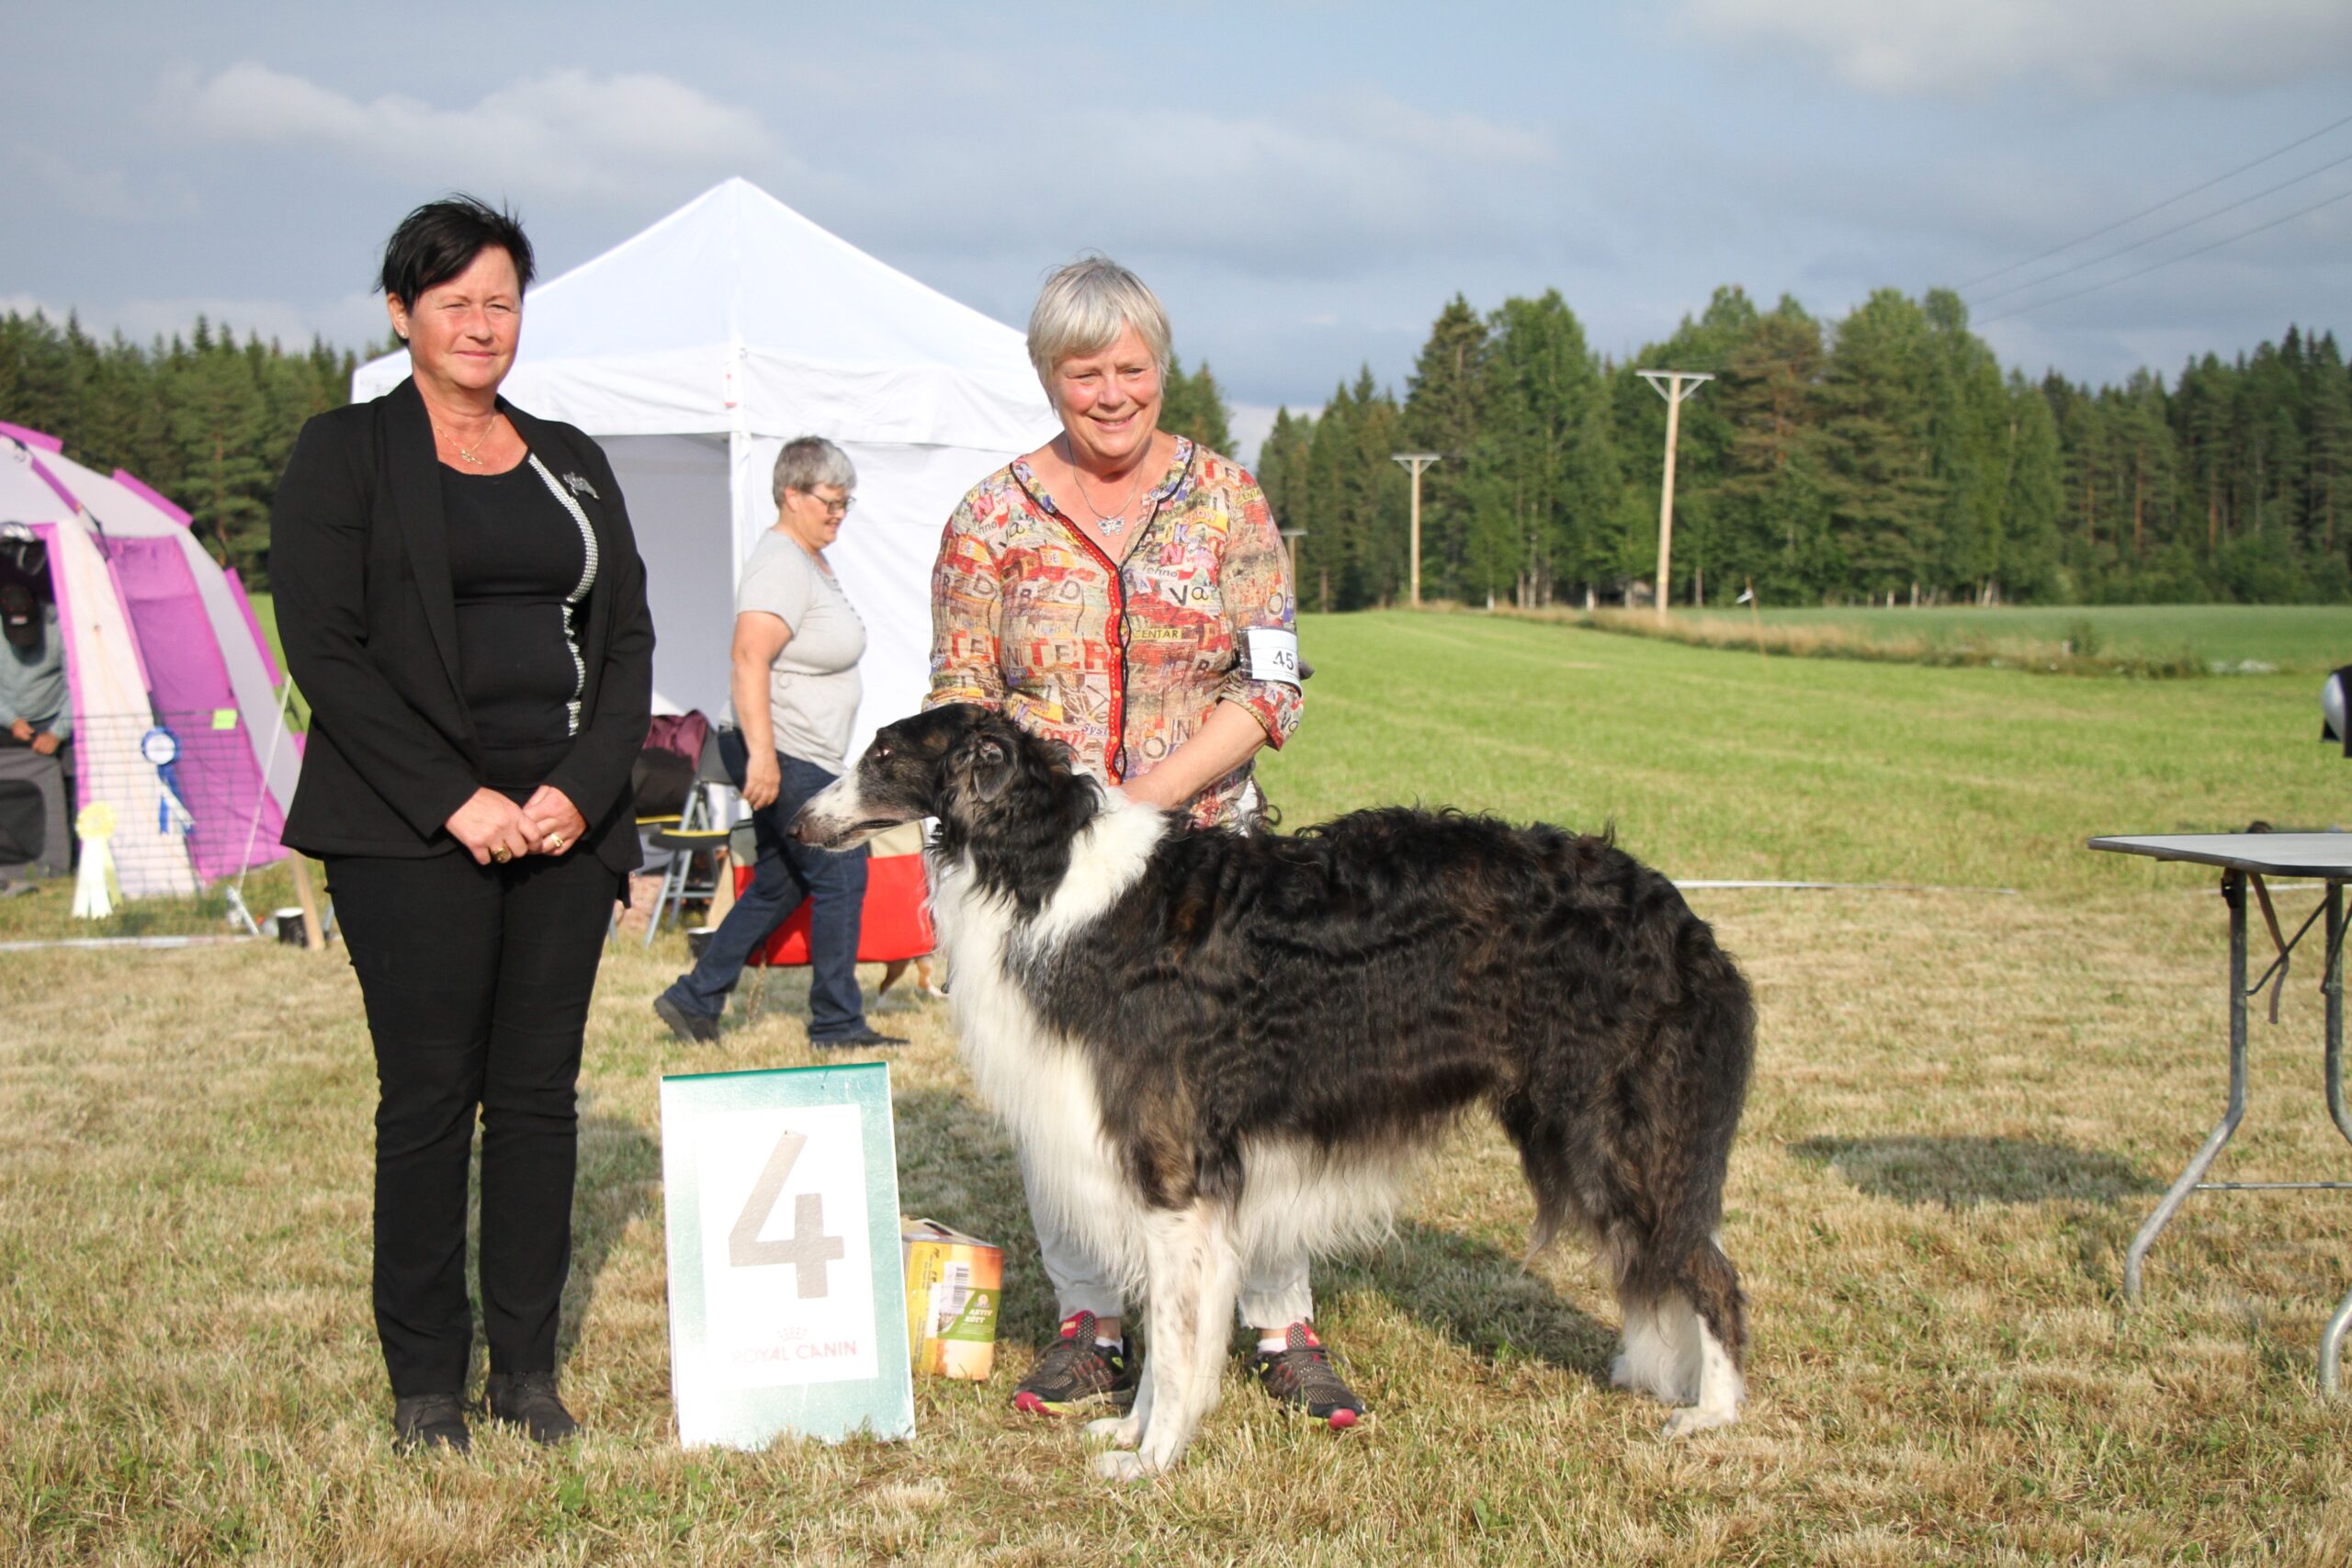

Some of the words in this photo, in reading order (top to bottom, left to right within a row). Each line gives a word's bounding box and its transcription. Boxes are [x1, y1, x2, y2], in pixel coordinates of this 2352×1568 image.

[1132, 628, 1179, 639] CENTAR
[1272, 649, 1295, 671] 45
[729, 1129, 845, 1300] 4
[732, 1345, 791, 1364] ROYAL
[796, 1340, 856, 1359] CANIN
